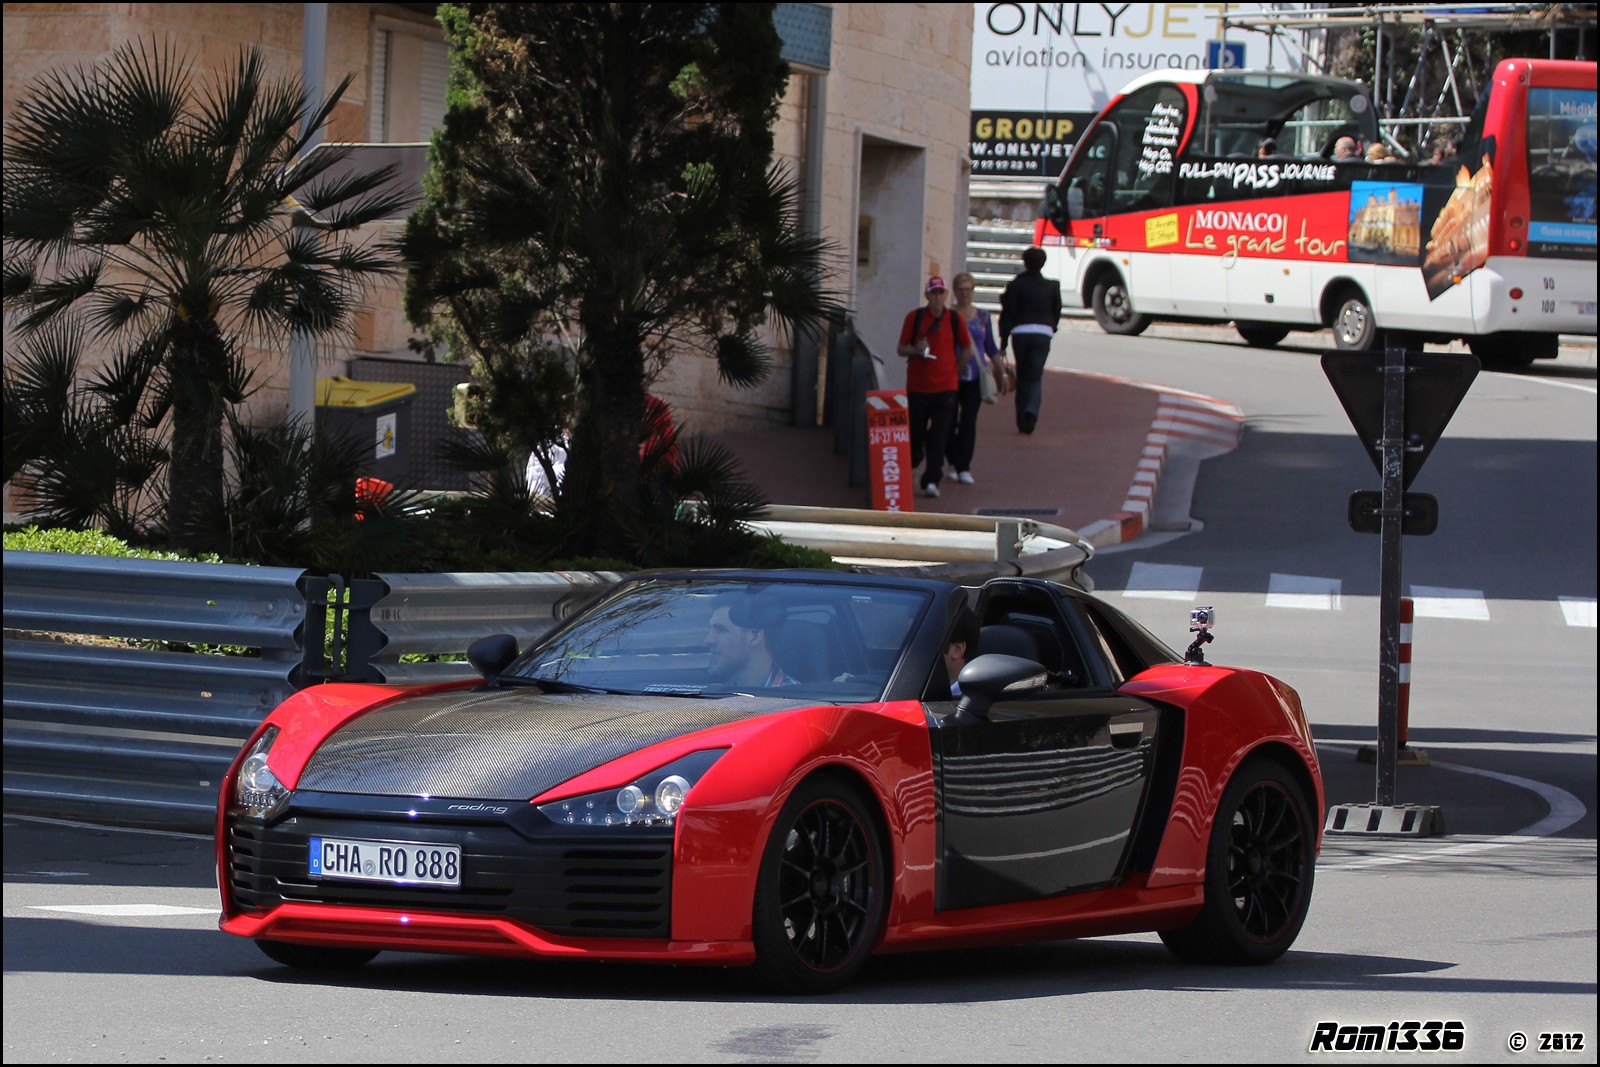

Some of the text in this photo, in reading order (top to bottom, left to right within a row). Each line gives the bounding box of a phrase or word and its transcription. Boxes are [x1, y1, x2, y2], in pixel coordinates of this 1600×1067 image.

[985, 47, 1087, 67] aviation
[975, 118, 1075, 141] GROUP
[1232, 163, 1280, 189] PASS
[1280, 163, 1337, 181] JOURNÉE
[1195, 210, 1283, 232] MONACO
[1185, 214, 1346, 270] Le grand tour
[1543, 277, 1555, 290] 90
[1541, 300, 1556, 313] 100
[882, 446, 900, 482] GRAND
[447, 803, 508, 815] roding
[313, 858, 319, 868] D
[323, 842, 458, 880] CHA RO 888
